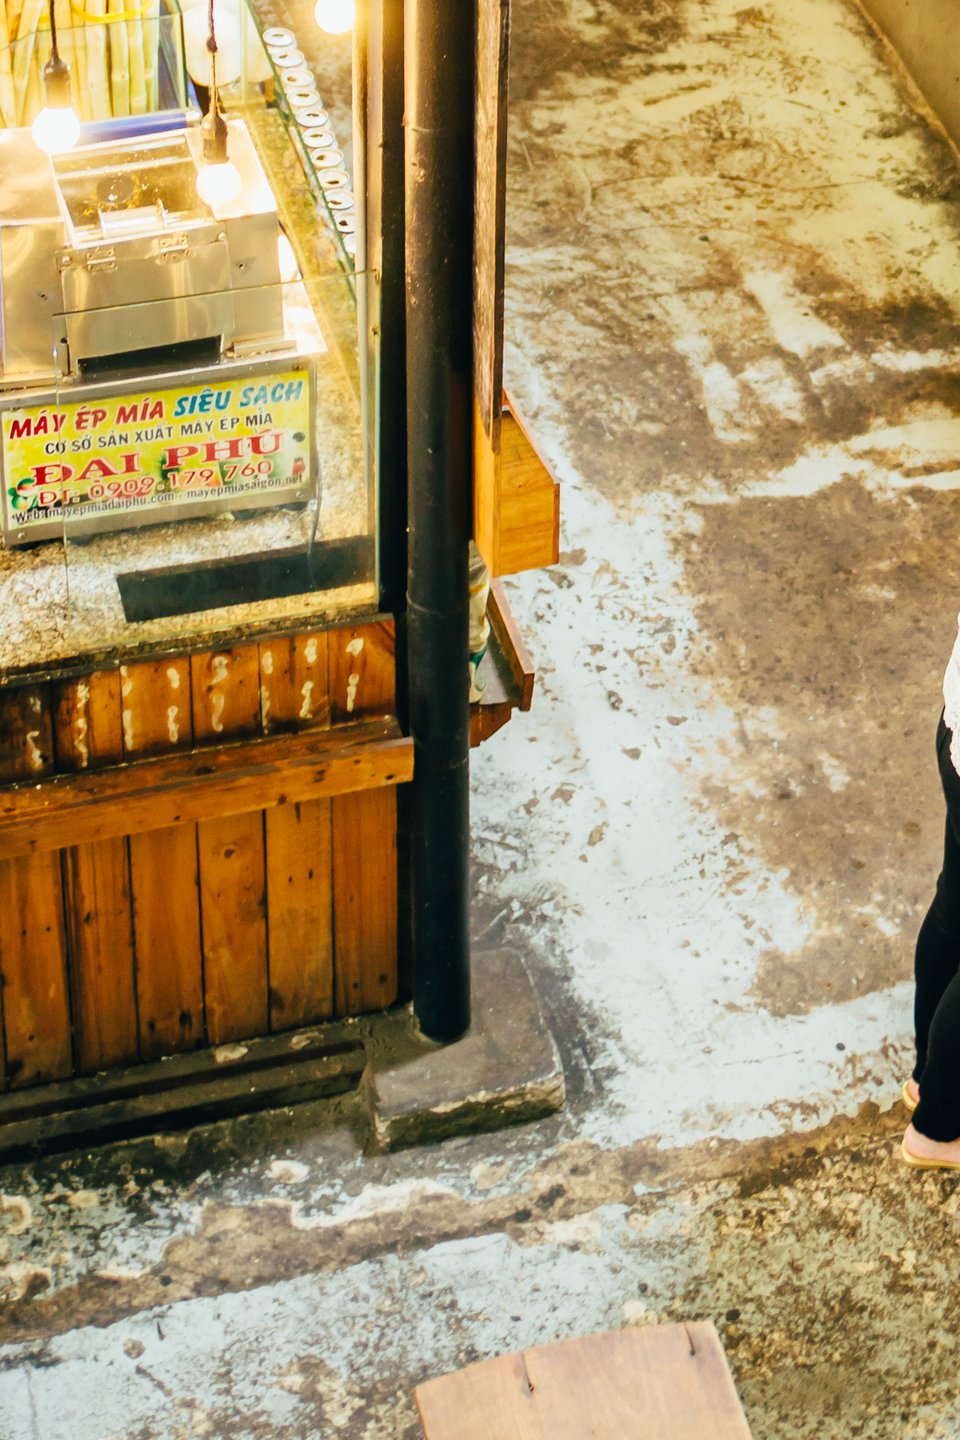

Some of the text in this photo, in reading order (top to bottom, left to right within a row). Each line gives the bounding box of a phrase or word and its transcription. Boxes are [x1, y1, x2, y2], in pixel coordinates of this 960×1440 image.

[9, 380, 303, 440] MÁY ÉP MÍA SIÊU SẠCH
[45, 439, 67, 455] CƠ
[180, 417, 213, 437] MÁY
[220, 415, 240, 431] ÉP
[245, 410, 273, 427] MÍA
[163, 428, 283, 469] PHÚ
[224, 459, 273, 482] 760
